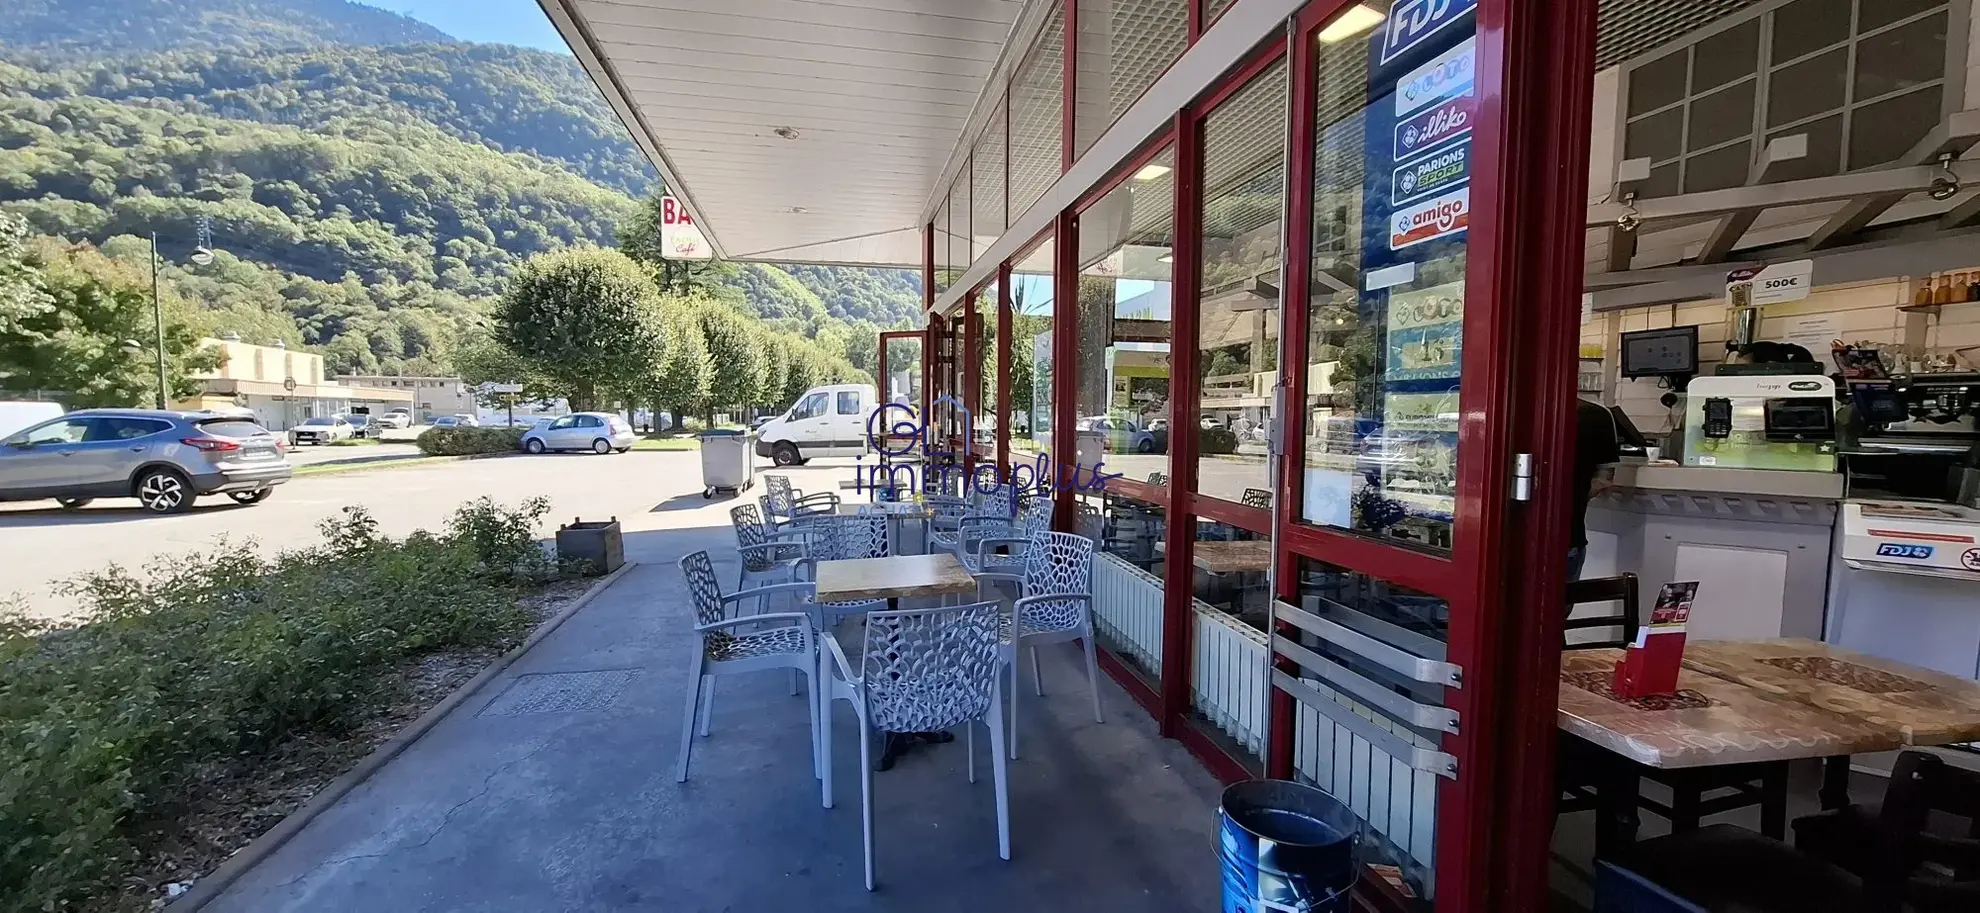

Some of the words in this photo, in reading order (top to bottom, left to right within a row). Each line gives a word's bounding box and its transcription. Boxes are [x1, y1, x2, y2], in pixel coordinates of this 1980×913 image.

[1418, 105, 1467, 144] illiko
[1417, 147, 1465, 176] PARIONS
[1419, 162, 1463, 186] SPORT
[1413, 201, 1463, 227] amigo
[1765, 277, 1798, 289] 500€
[1879, 545, 1910, 556] FDJ
